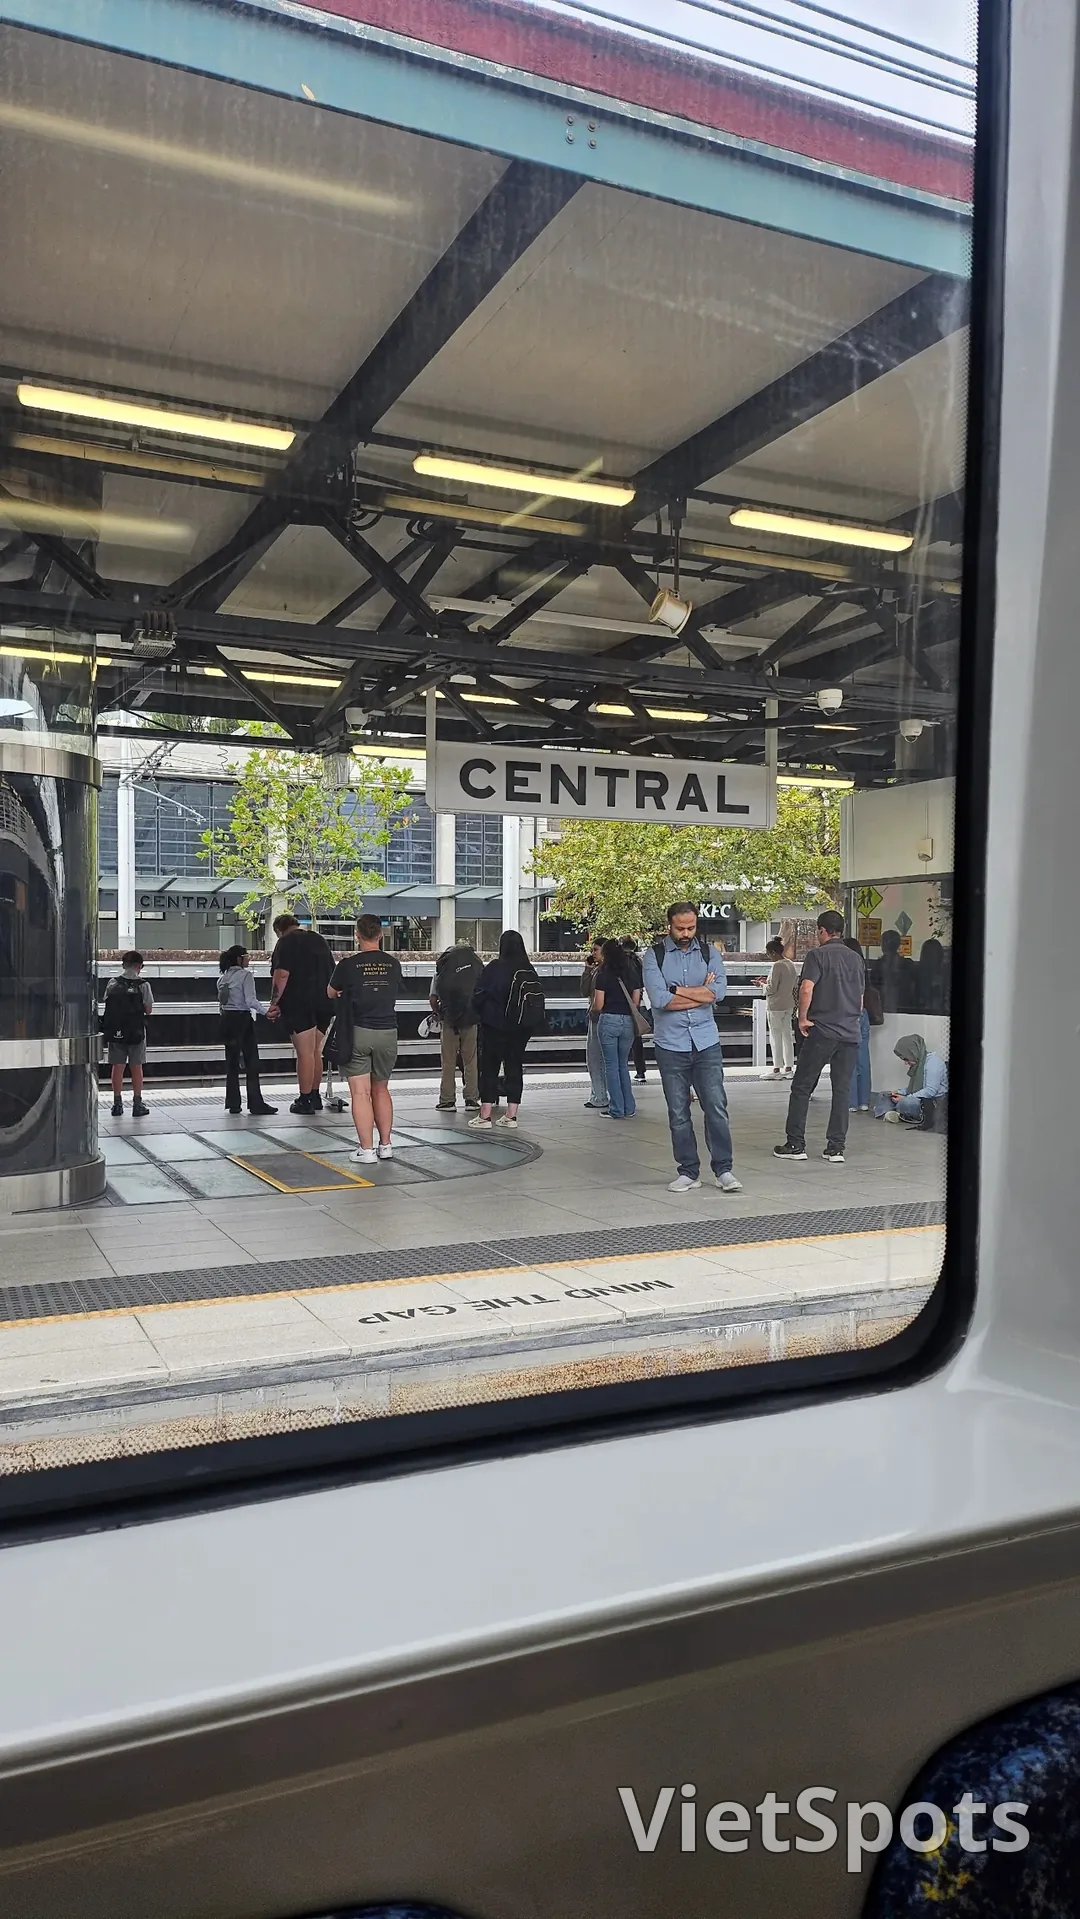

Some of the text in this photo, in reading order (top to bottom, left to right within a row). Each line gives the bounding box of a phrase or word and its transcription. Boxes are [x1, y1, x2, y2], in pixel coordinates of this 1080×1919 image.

[459, 758, 750, 815] CENTRAL
[140, 895, 235, 909] CENTRAL
[698, 903, 731, 918] KFC
[358, 1279, 675, 1325] MIND THE GAP
